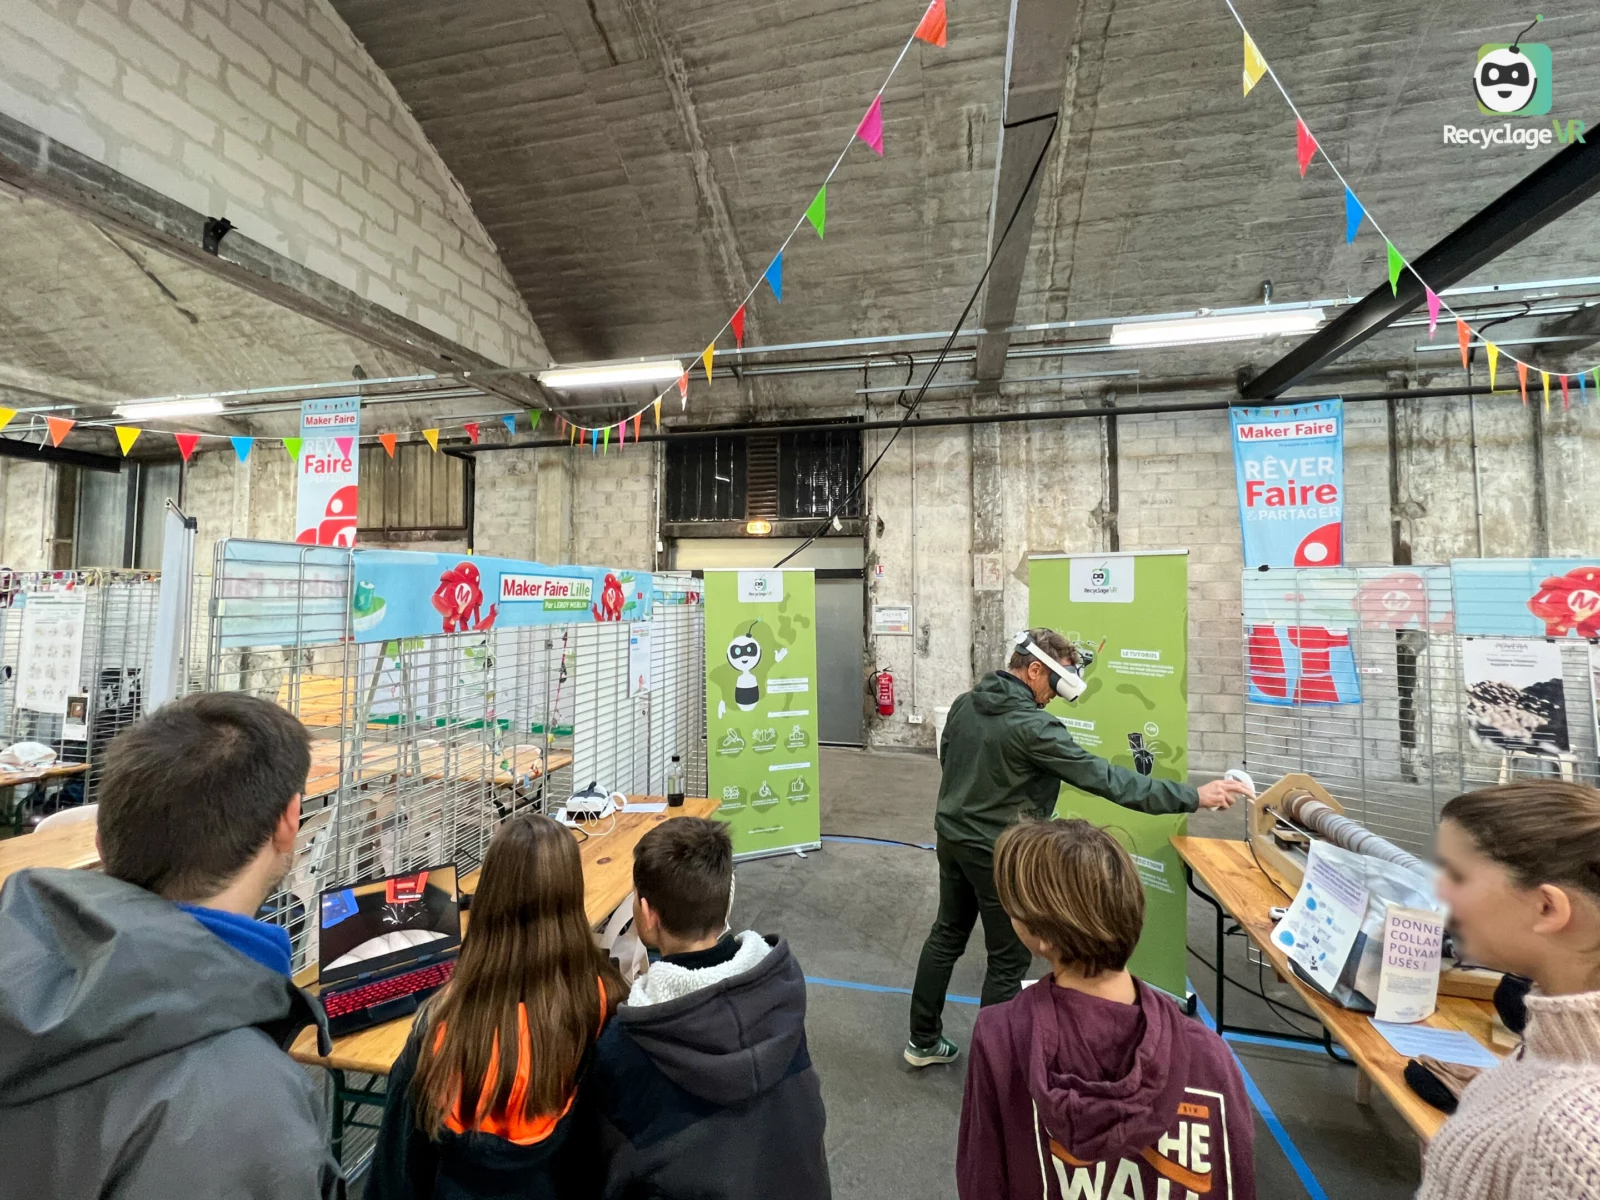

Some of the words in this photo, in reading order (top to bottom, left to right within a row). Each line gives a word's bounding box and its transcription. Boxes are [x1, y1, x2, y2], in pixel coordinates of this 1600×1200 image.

[305, 416, 332, 426] Maker
[334, 414, 356, 424] Faire
[1240, 426, 1290, 438] Maker
[1295, 422, 1333, 435] Faire
[304, 454, 353, 474] Faire
[1244, 455, 1335, 480] RÊVER
[1245, 479, 1338, 507] Faire
[503, 579, 542, 597] Maker
[544, 580, 569, 597] Faire
[570, 582, 590, 597] Lille
[1388, 955, 1419, 970] USÉS
